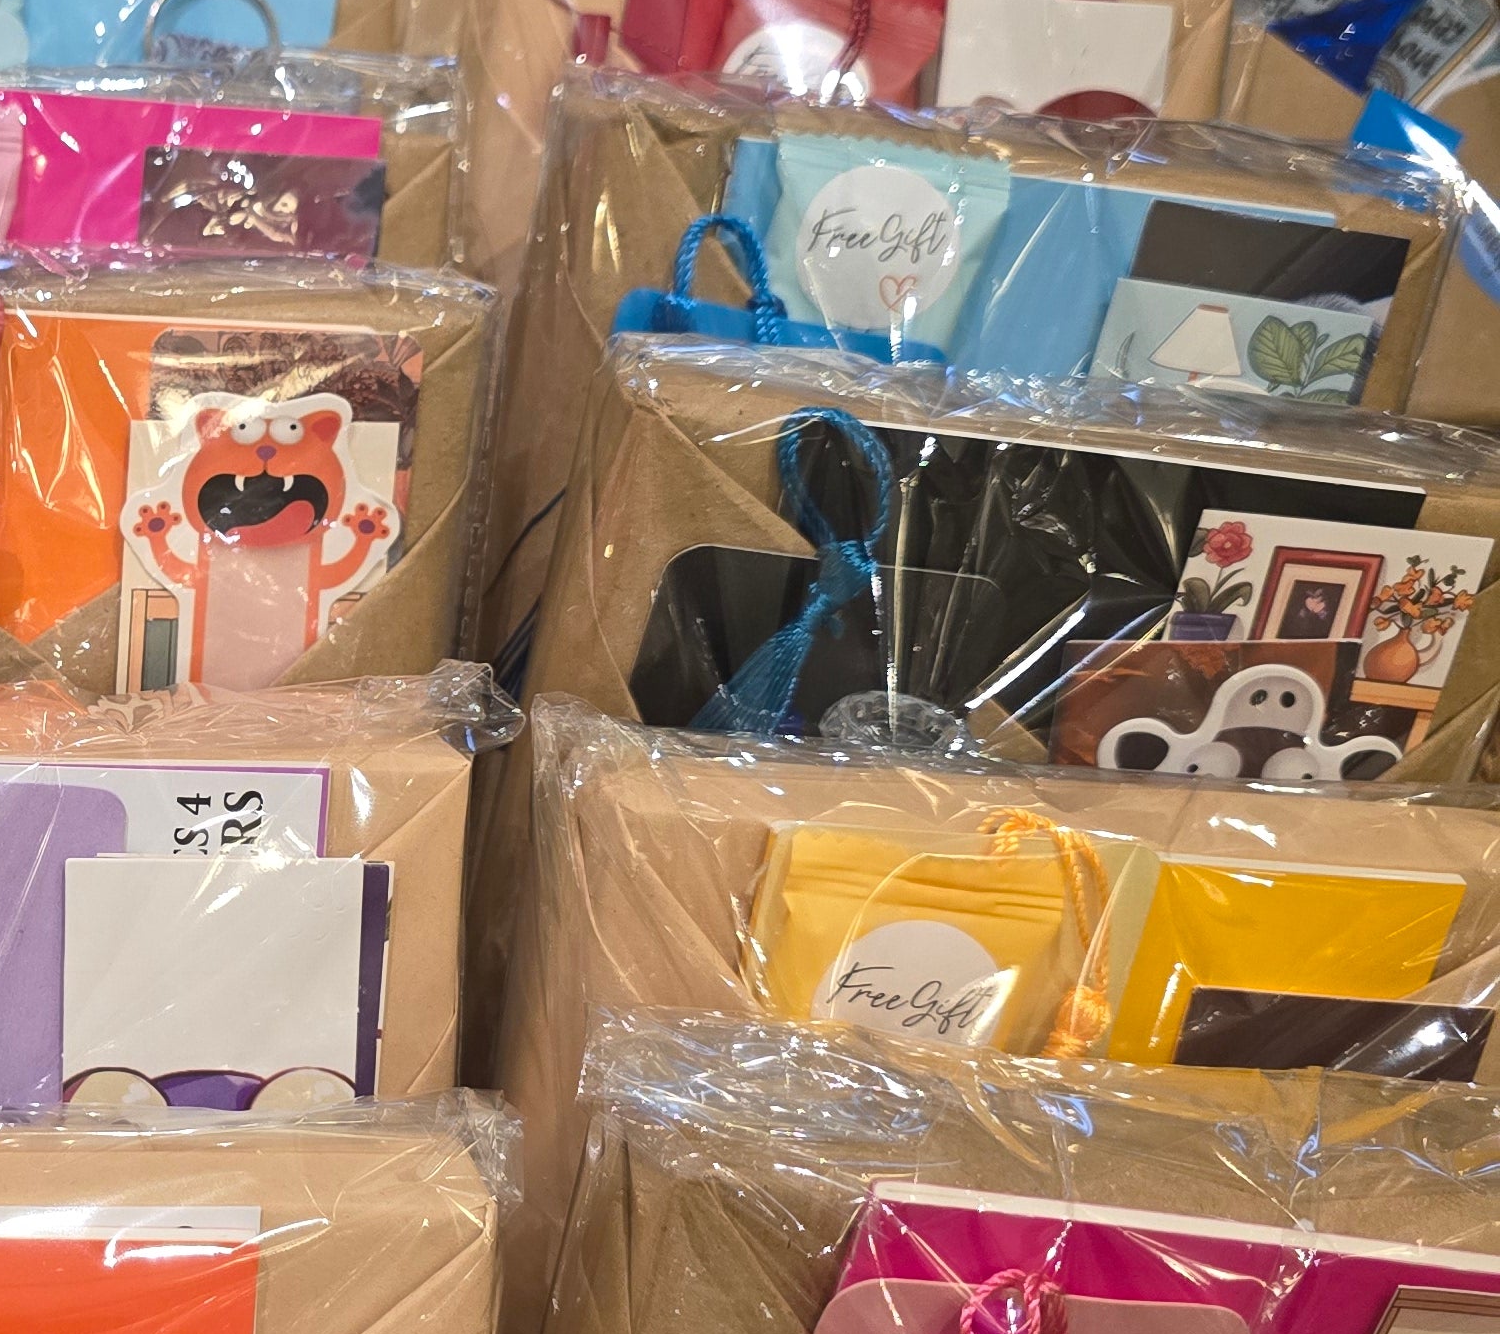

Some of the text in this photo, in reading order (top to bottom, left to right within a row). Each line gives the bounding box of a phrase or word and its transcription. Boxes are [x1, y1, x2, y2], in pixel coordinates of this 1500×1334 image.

[808, 208, 947, 264] Free Gift
[826, 961, 993, 1035] Free Gift
